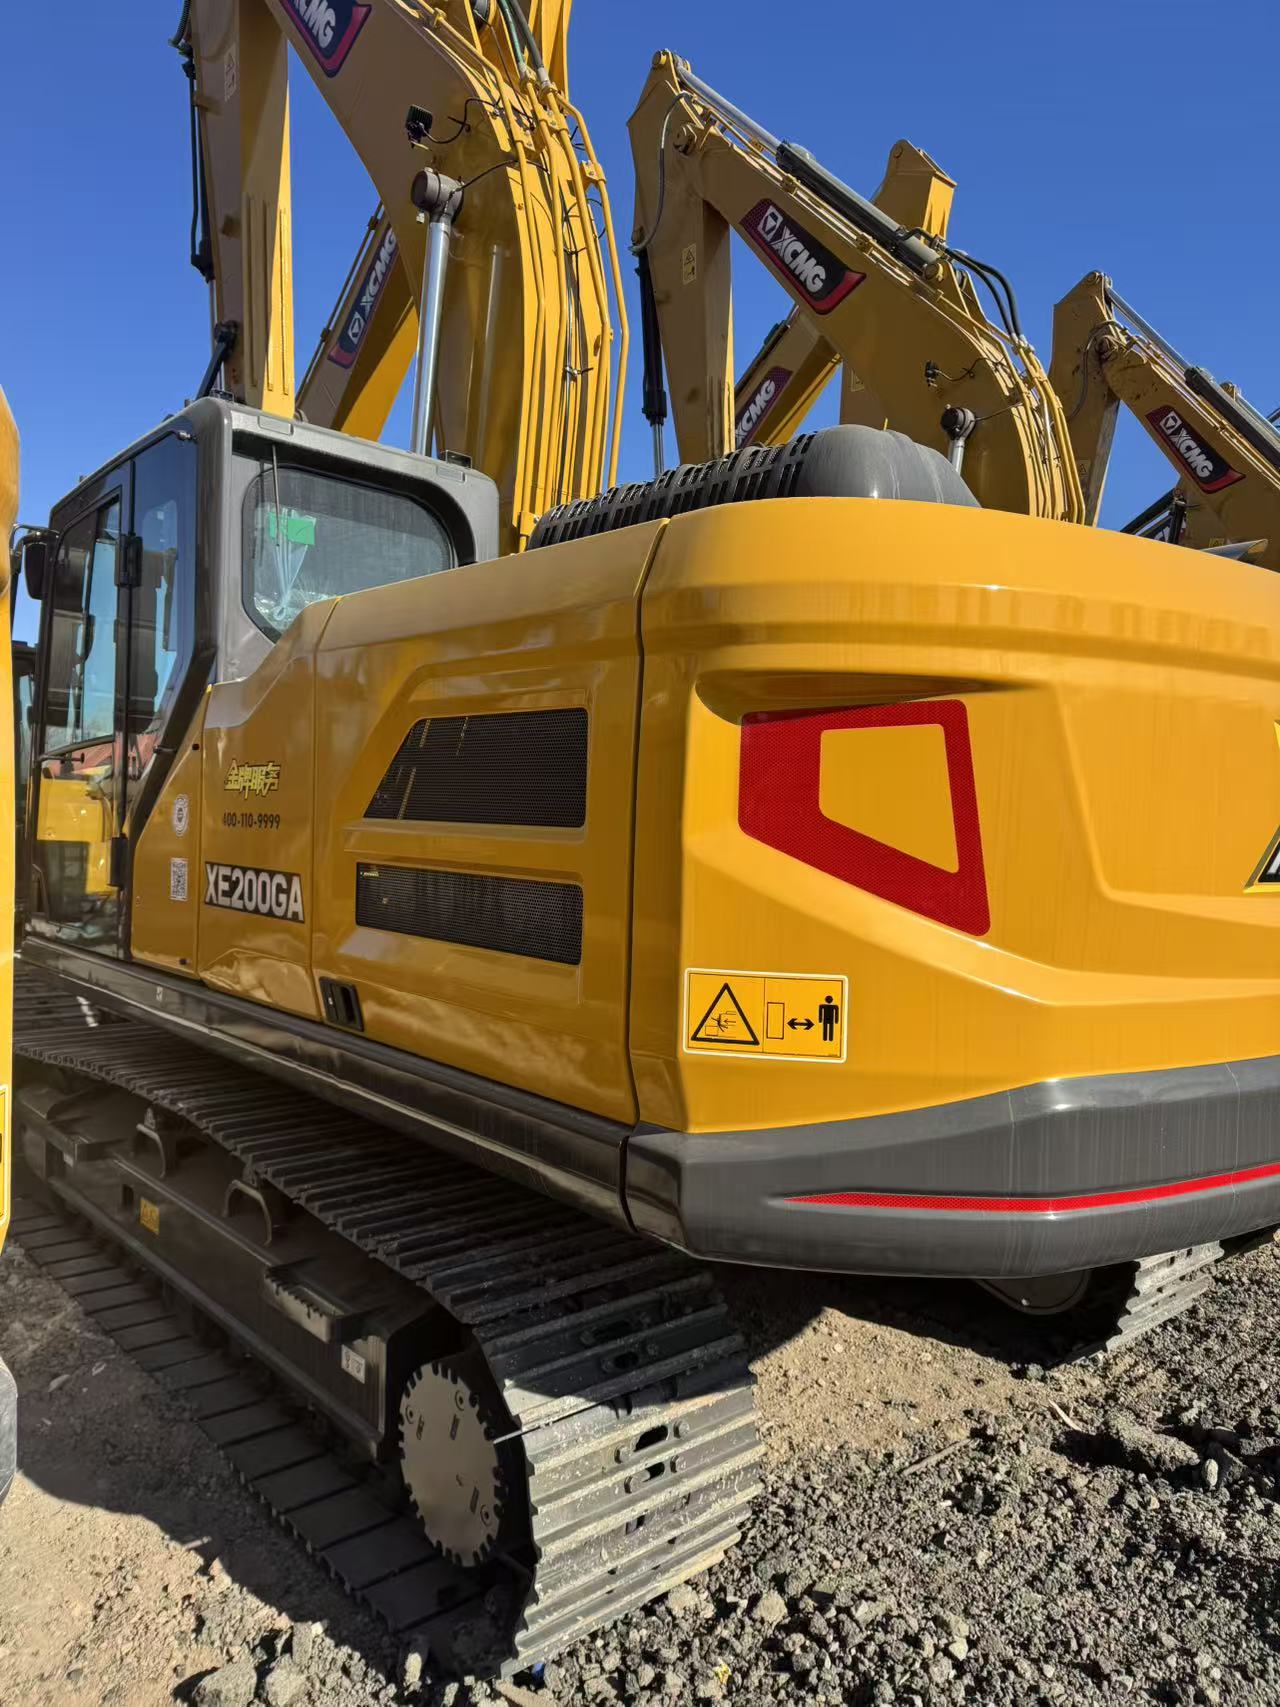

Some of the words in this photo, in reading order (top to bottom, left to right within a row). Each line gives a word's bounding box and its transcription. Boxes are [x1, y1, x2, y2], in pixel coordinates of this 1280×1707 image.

[360, 227, 396, 321] XCMG
[769, 225, 826, 293] XCMG
[1168, 427, 1214, 477] XCMG
[224, 758, 281, 800] 金牌服务
[205, 863, 304, 921] XE200GA
